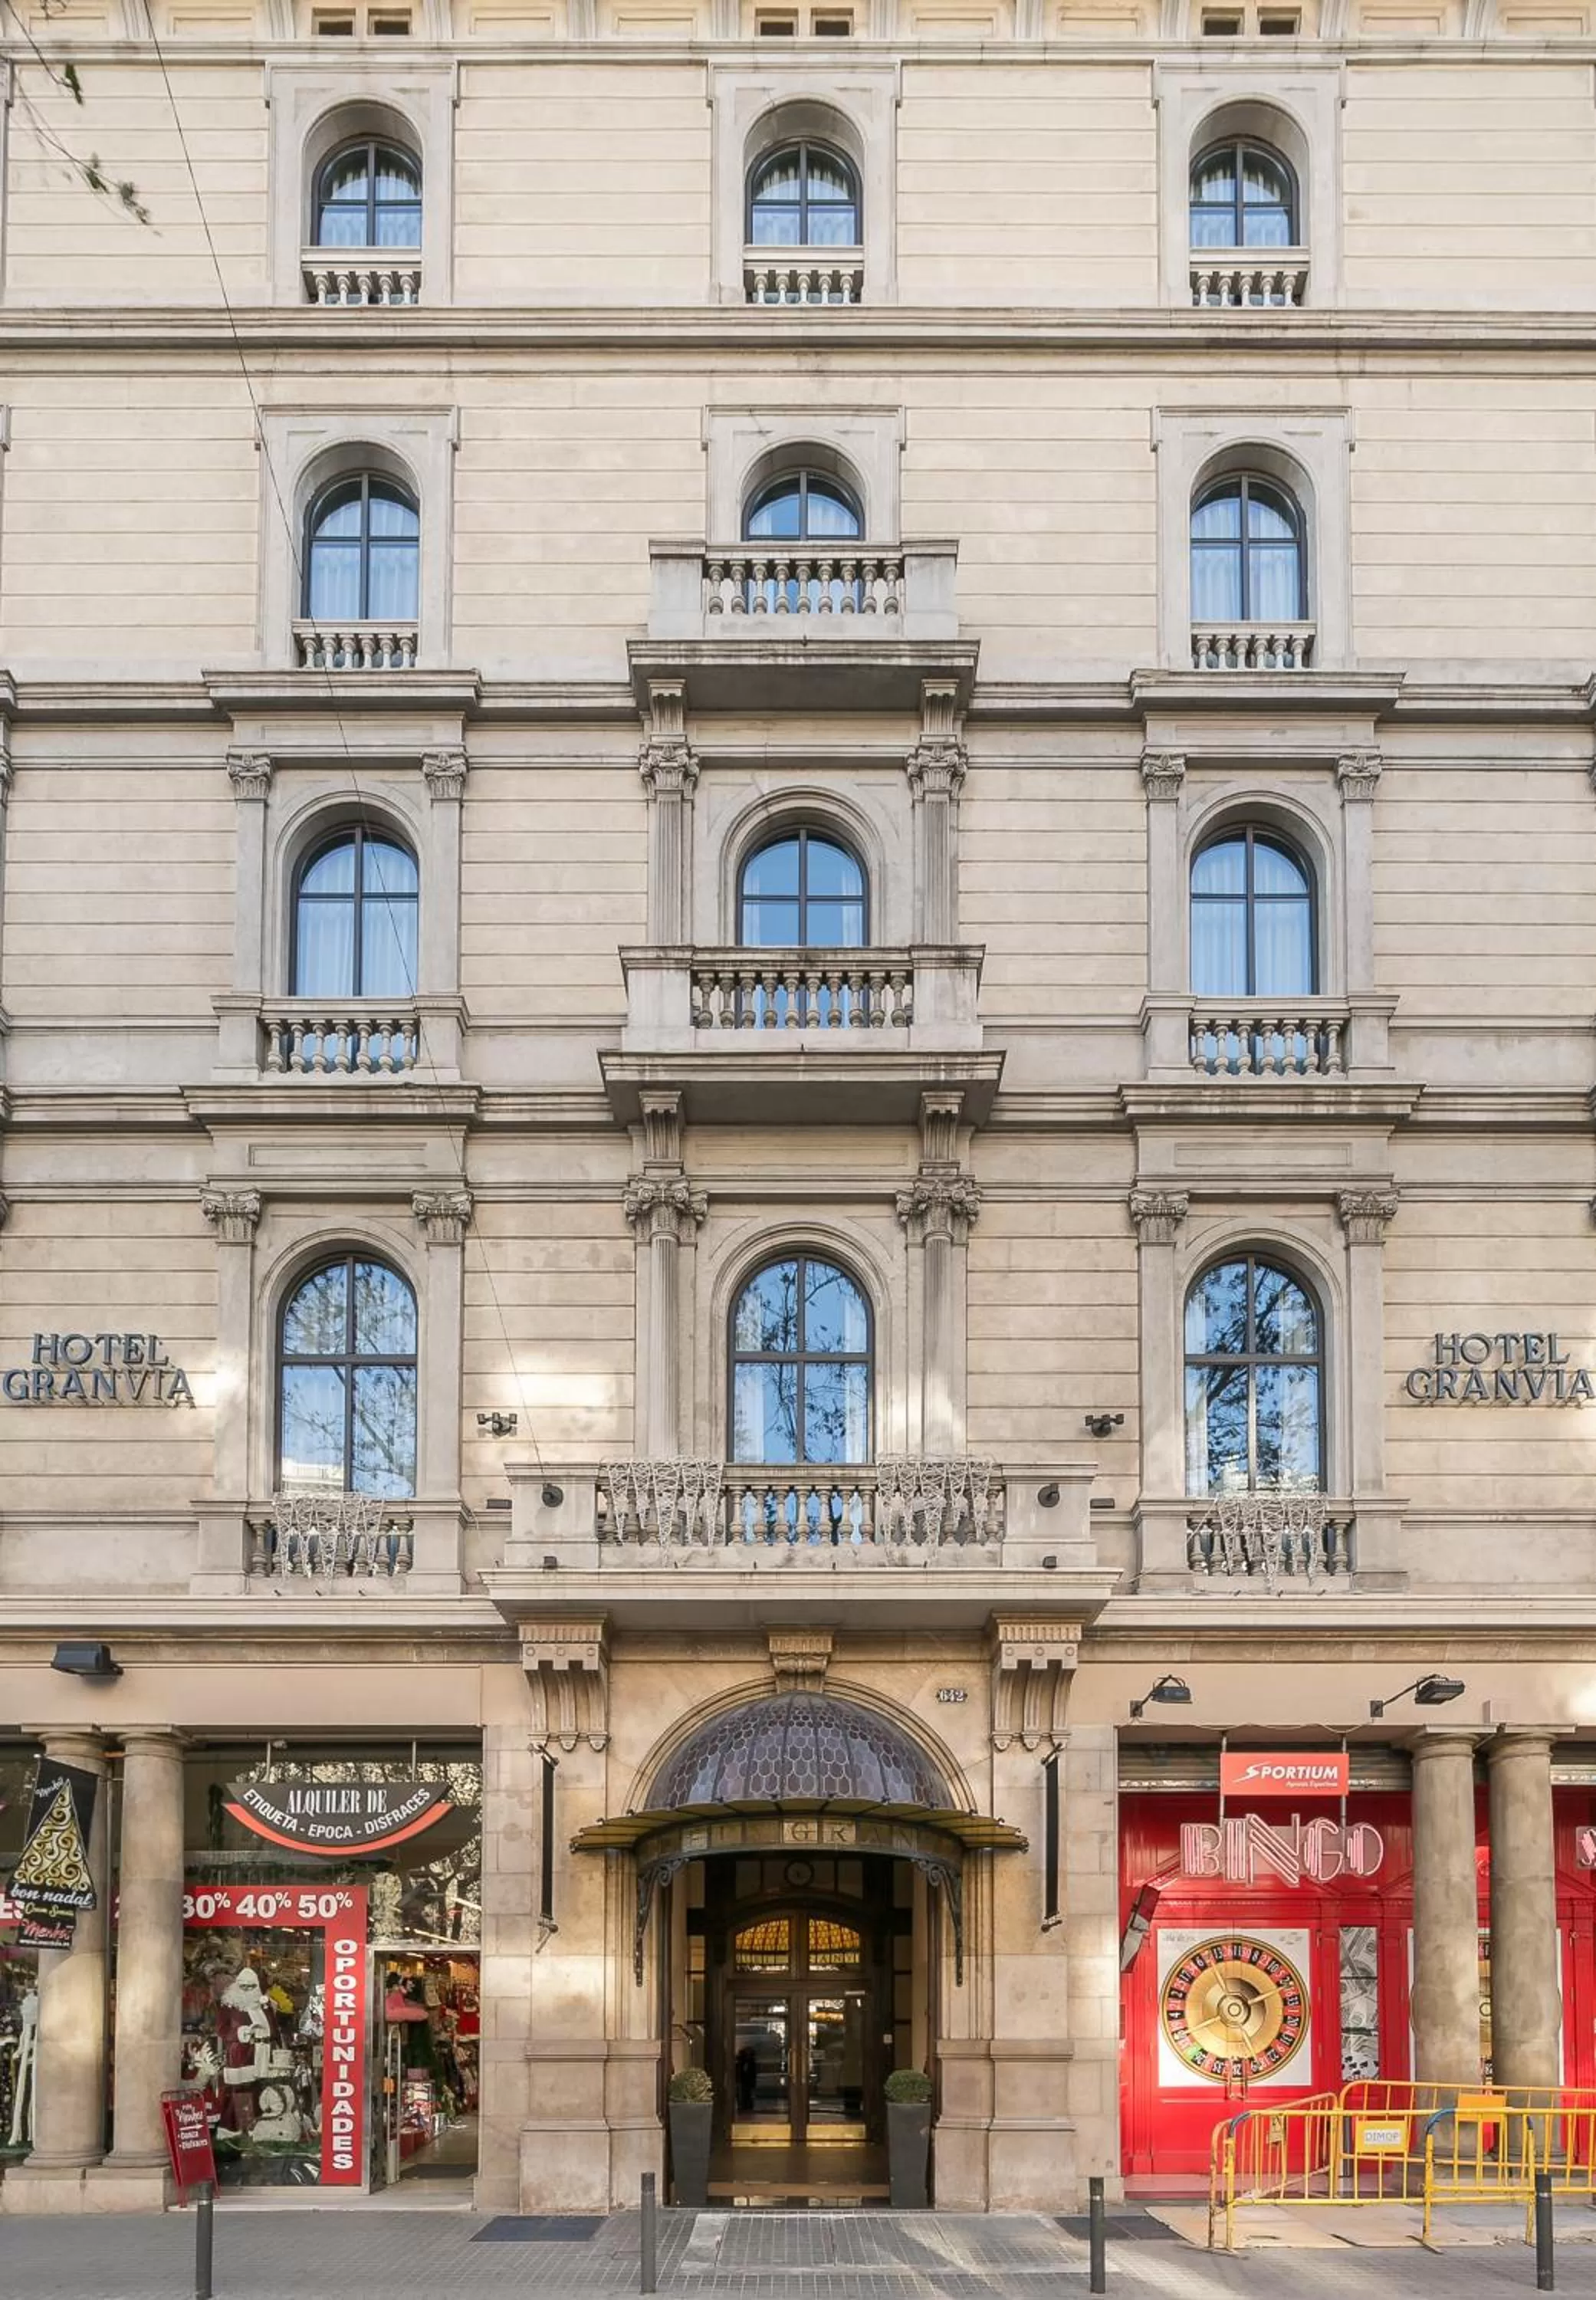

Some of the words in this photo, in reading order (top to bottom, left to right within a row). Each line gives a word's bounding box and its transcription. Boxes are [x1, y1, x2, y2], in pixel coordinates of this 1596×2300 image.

[31, 1333, 169, 1365] HOTEL
[1434, 1332, 1571, 1365] HOTEL
[2, 1368, 195, 1401] GRANVIA
[1405, 1367, 1595, 1400] GRANVIA
[1233, 1762, 1338, 1783] SPORTIUM
[243, 1788, 297, 1832] ETIQUETA
[307, 1823, 353, 1839] EPOCA
[364, 1787, 431, 1834] DISFRACES
[286, 1789, 361, 1815] ALQUILER
[366, 1789, 387, 1814] DE
[1181, 1813, 1384, 1887] BINGO
[42, 1891, 94, 1907] nadal
[236, 1892, 292, 1919] 40%
[297, 1892, 353, 1919] 50%
[330, 1939, 358, 2169] OPORTUNIDADES
